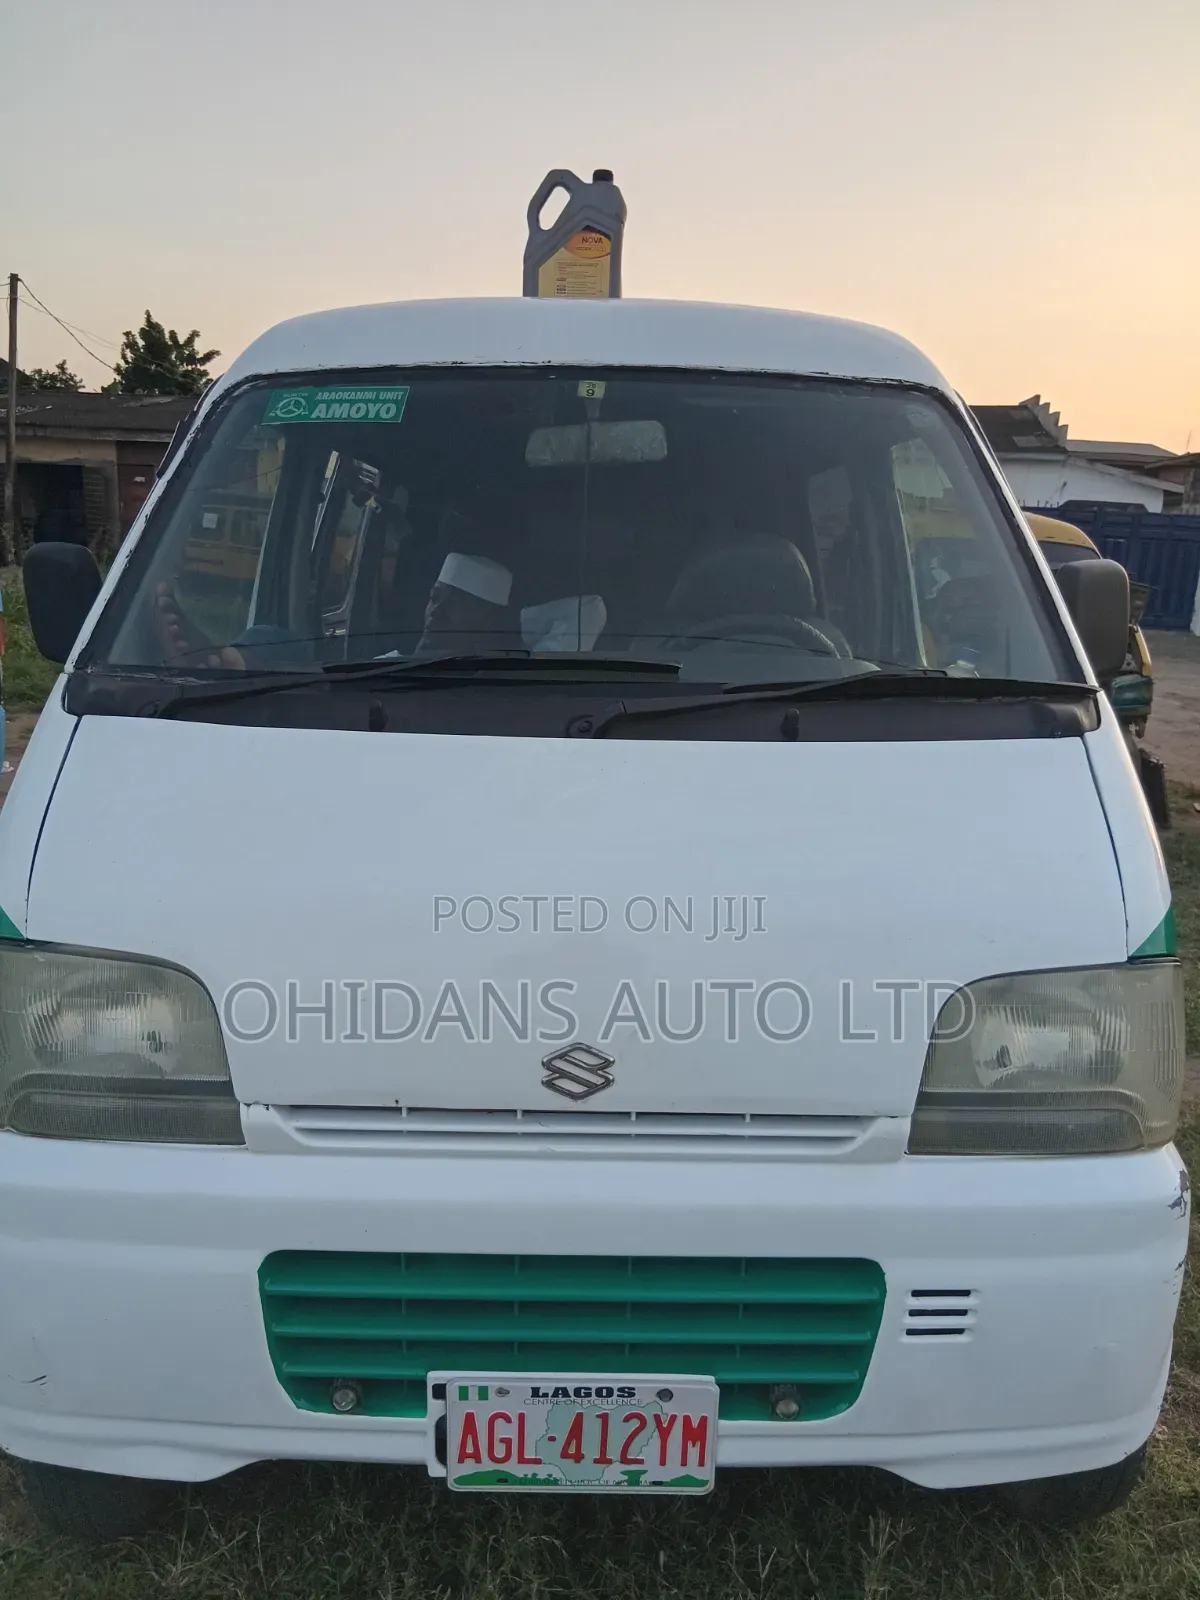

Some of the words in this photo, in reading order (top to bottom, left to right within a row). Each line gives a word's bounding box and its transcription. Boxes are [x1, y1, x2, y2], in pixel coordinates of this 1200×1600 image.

[315, 392, 376, 400] ARAOKANMI
[378, 392, 404, 400] UNIT
[586, 388, 595, 397] 9
[310, 403, 397, 419] AMOYO
[530, 1386, 636, 1398] LAGOS
[524, 1398, 561, 1406] CENTRE
[563, 1398, 579, 1406] OF
[580, 1398, 642, 1406] EXCELLENCE
[457, 1412, 708, 1467] AGL-412YM
